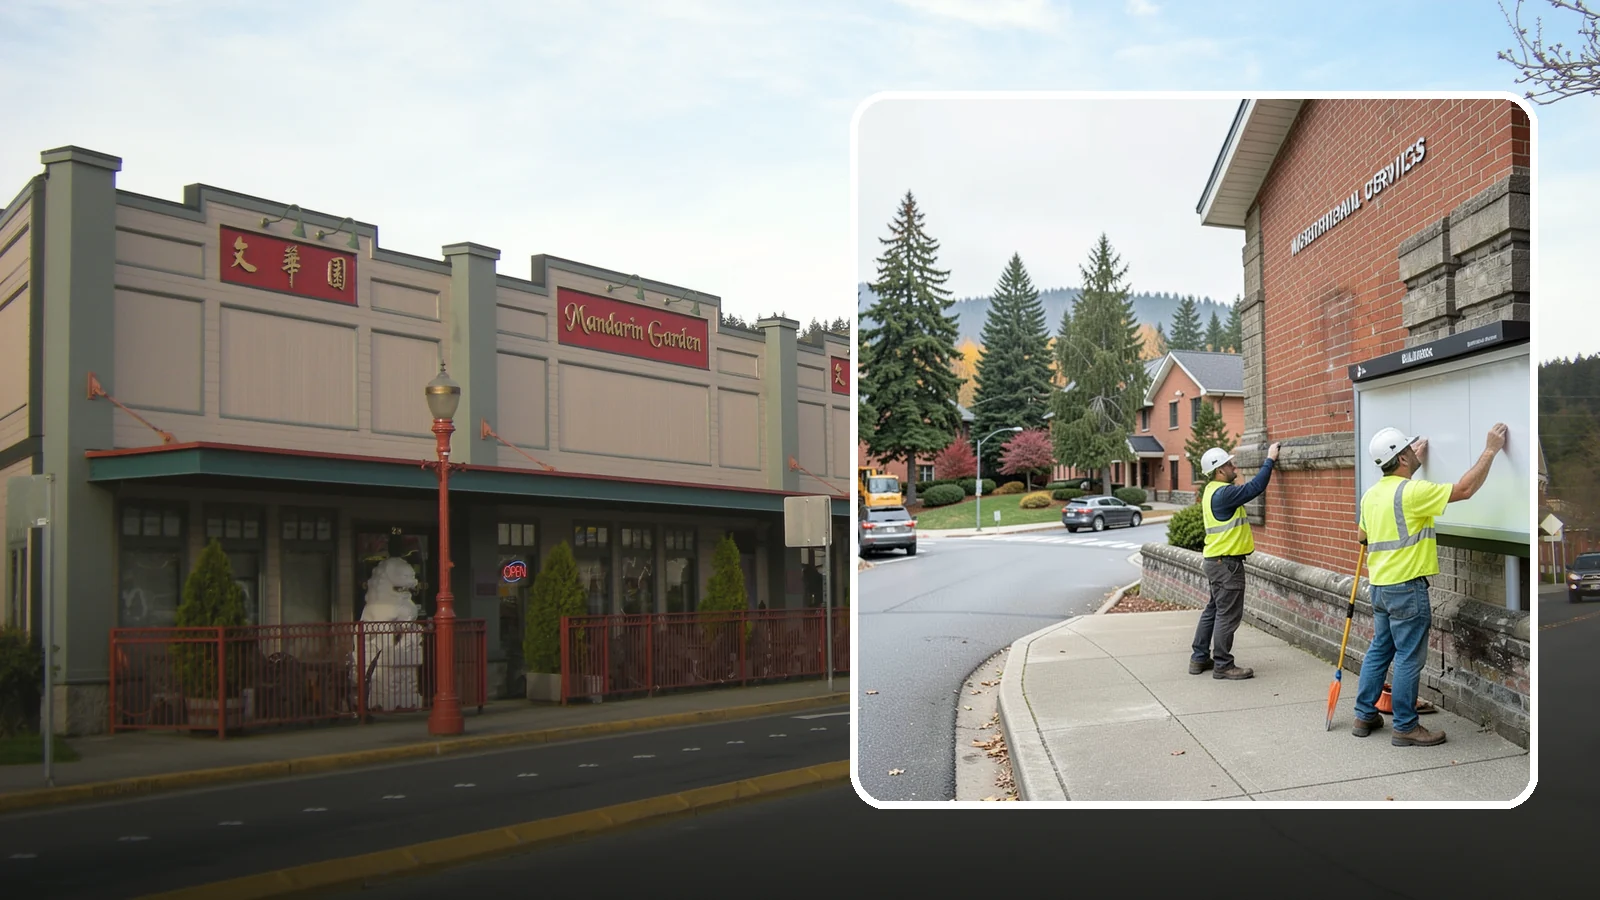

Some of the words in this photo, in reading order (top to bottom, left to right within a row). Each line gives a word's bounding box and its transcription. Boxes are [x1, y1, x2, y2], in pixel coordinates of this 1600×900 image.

[564, 302, 644, 341] Mandarin
[648, 320, 701, 352] Garden
[503, 565, 527, 578] OPEN
